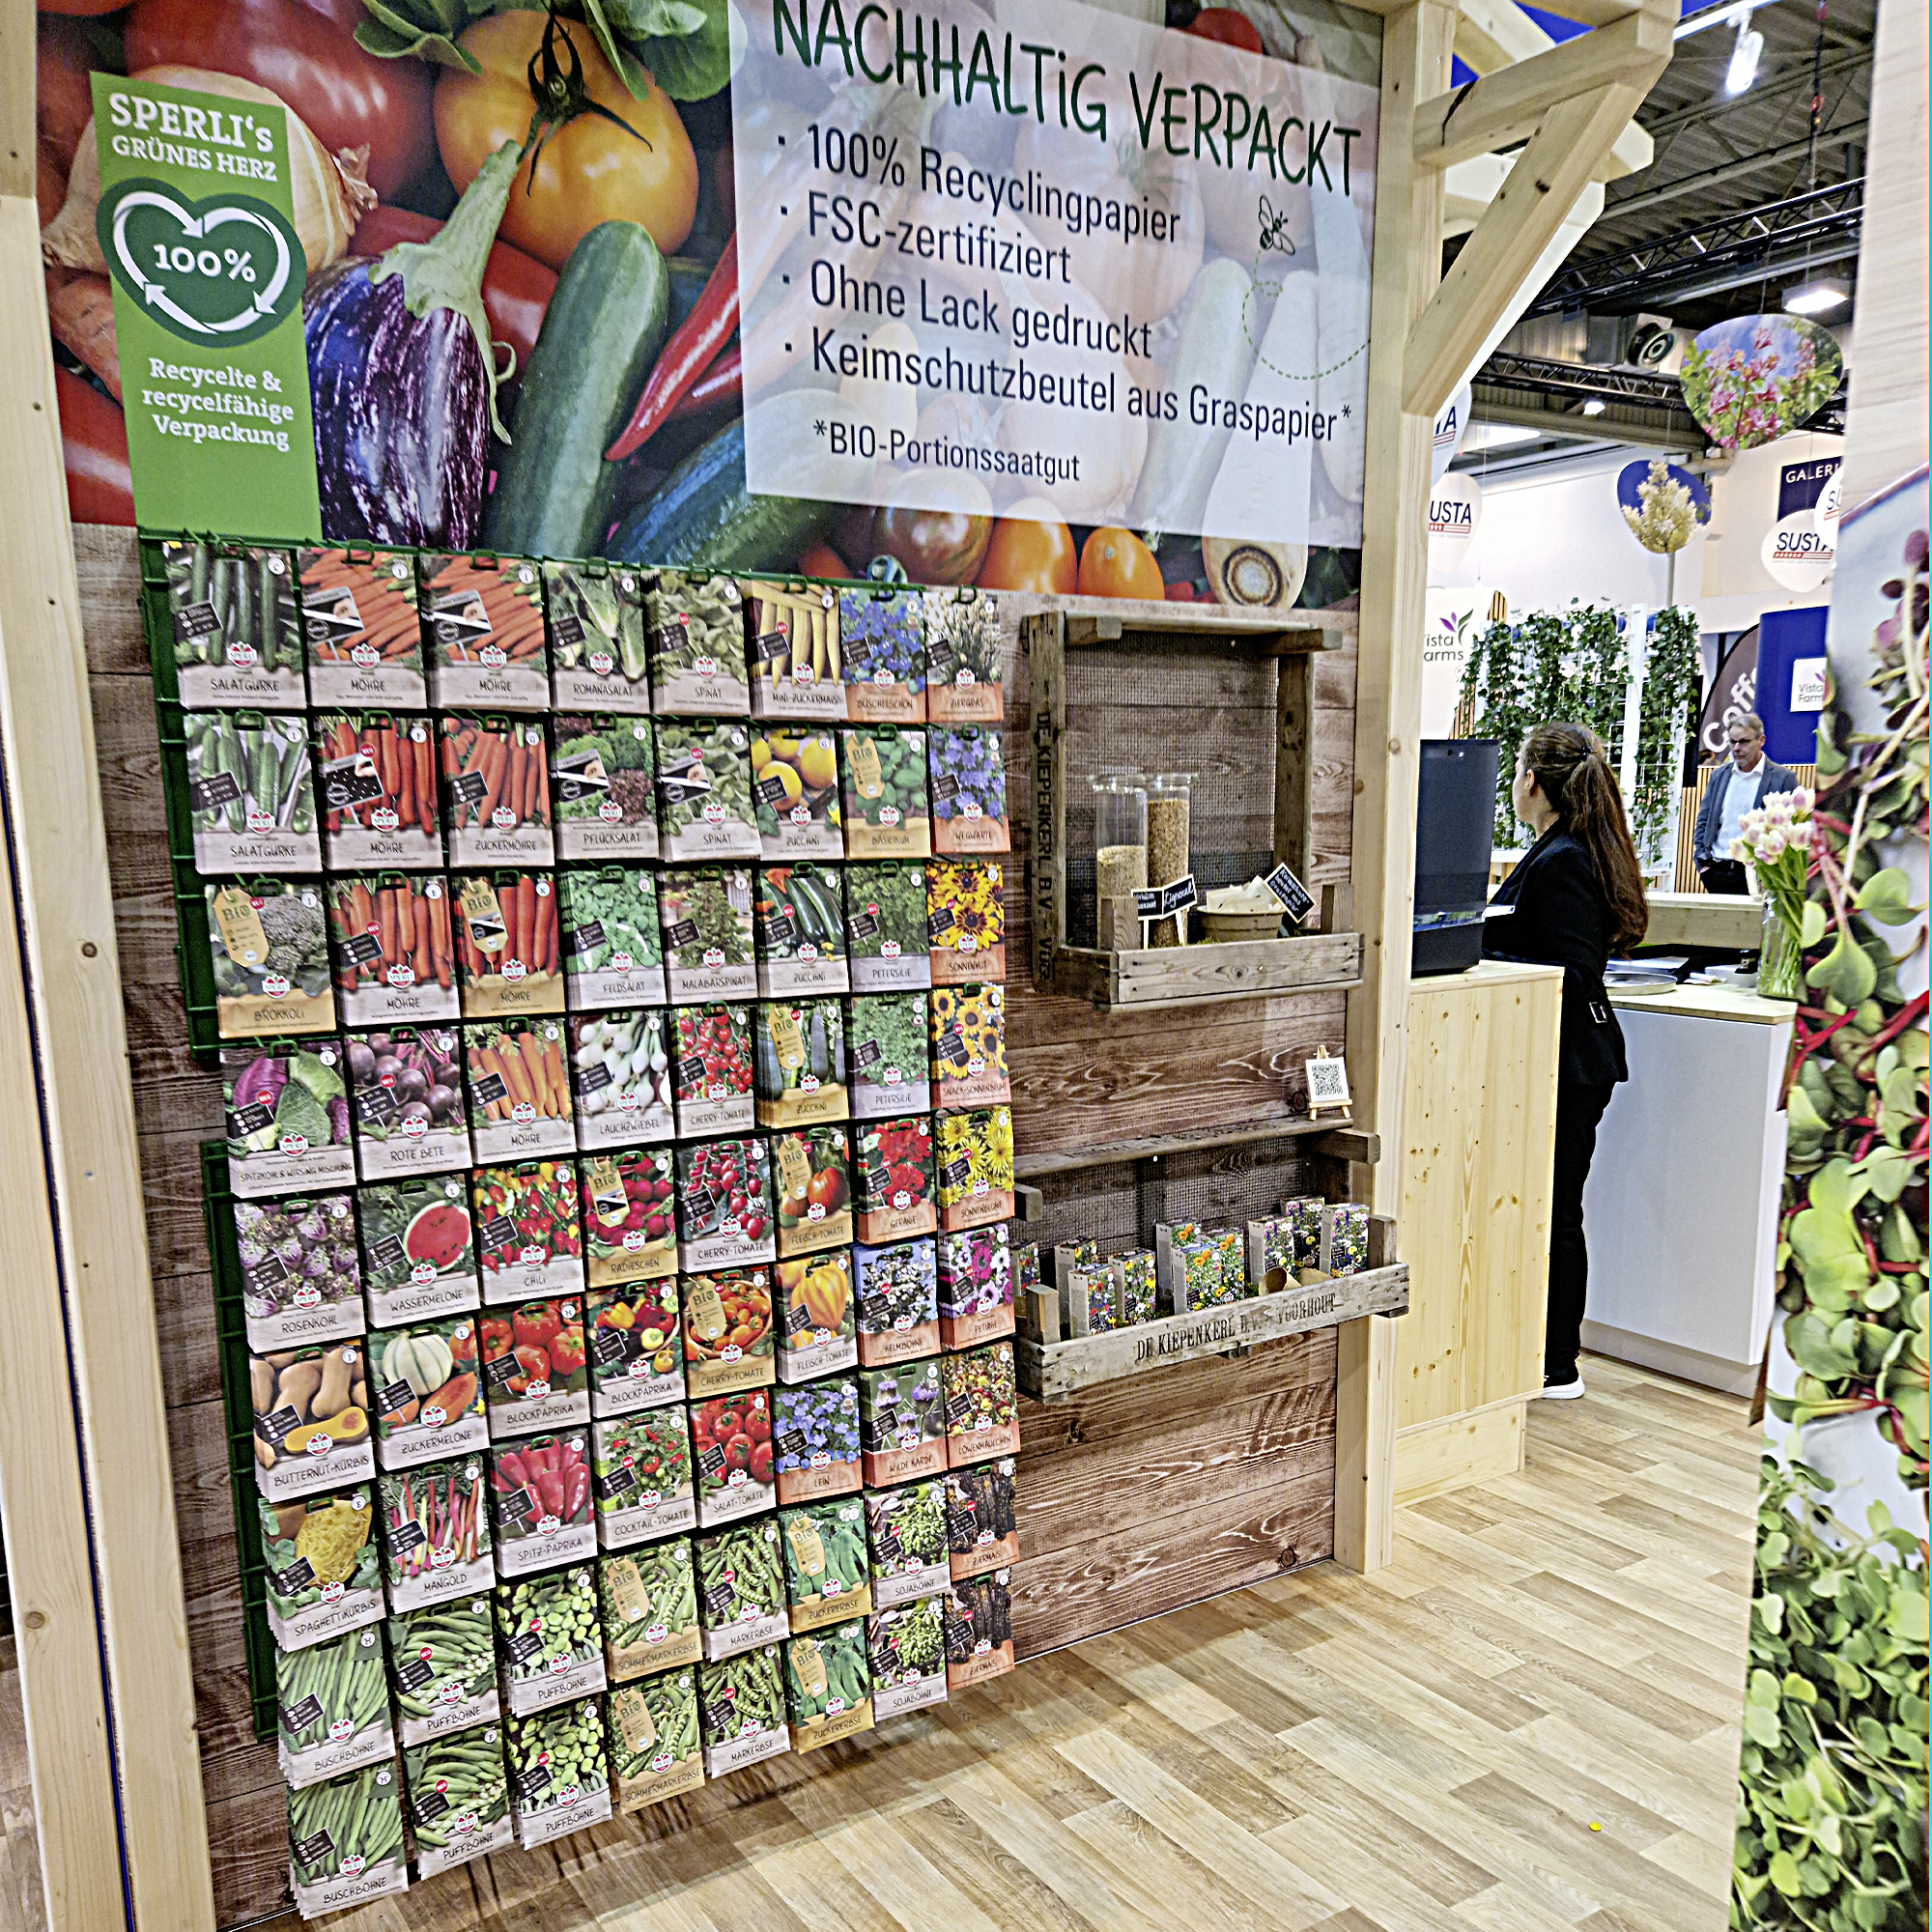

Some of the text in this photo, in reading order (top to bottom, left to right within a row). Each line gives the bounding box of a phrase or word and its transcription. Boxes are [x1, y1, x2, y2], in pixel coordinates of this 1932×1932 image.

[1130, 71, 1362, 196] VERPACKT
[112, 135, 277, 183] GRÜNES HERZ
[808, 124, 1181, 243] 100% Recyclingpapier
[809, 190, 1072, 284] FSC-zertifiziert
[154, 242, 257, 283] 100%
[810, 260, 1152, 359] Ohne Lack gedruckt
[149, 357, 282, 392] Recycelte &
[812, 327, 1116, 413] Keimschutzbeutel
[1127, 383, 1179, 421] aus
[142, 388, 295, 422] recycelfähige
[153, 413, 290, 452] Verpackung
[211, 677, 280, 693] SALATGURKE
[351, 678, 385, 691] MÖHRE
[479, 678, 513, 692] MÖHRE
[573, 683, 634, 697] ROMANASALAT
[1037, 711, 1052, 737] DE
[1037, 745, 1053, 870] KIEPENKERL
[370, 841, 405, 854] MÖHRE
[475, 838, 537, 851] ZUCKERMÖHRE
[583, 832, 641, 844] PFLÜCKSALAT
[230, 844, 297, 858] SALATGURKE
[949, 961, 988, 972] SONNENHUT
[500, 989, 531, 1003] MÖHRE
[604, 982, 645, 993] FELDSALAT
[386, 997, 421, 1009] MÖHRE
[258, 1093, 271, 1102] NEU
[691, 1111, 746, 1125] CHERRY-TOMATE
[511, 1133, 541, 1146] MÖHRE
[390, 1146, 445, 1161] ROTE BETE
[960, 1201, 1003, 1218] SONNENBLUME
[697, 1242, 764, 1260] CHERRY-TOMATE
[390, 1289, 464, 1312] WASSERMELONE
[281, 1317, 338, 1335] ROSENKOHL
[1158, 1316, 1236, 1355] KIEPENKERL
[1276, 1293, 1336, 1325] VOORHOUT
[884, 1338, 923, 1352] HELMBOHNE
[700, 1368, 764, 1386] CHERRY-TOMATE
[402, 1431, 472, 1454] ZUCKERMELONE
[958, 1435, 1011, 1454] LÖWENMÄULCHEN
[911, 1455, 932, 1467] KARDE
[714, 1490, 764, 1513] SALAT-TOMATE
[424, 1574, 468, 1593] MANGOLD
[895, 1578, 936, 1597] SOJABOHNE
[809, 1600, 859, 1620] ZUCKERERBSE
[730, 1625, 774, 1646] MARKERBSE
[618, 1641, 697, 1671] SOMMERMARKERBSE
[537, 1676, 588, 1700] PUFFBOHNE
[893, 1690, 932, 1708] SOJABOHNE
[427, 1704, 482, 1730] PUFFBOHNE
[813, 1714, 862, 1741] ZUCKERERBSE
[314, 1740, 376, 1772] BUSCHBOHNE
[731, 1739, 774, 1762] MARKERBSE
[436, 1781, 448, 1793] NEU
[625, 1767, 701, 1803] SOMMERMARKERBSE
[545, 1807, 595, 1833] PUFFBOHNE
[442, 1832, 495, 1860] PUFFBOHNE
[324, 1876, 387, 1904] BUSCHBOHNE
